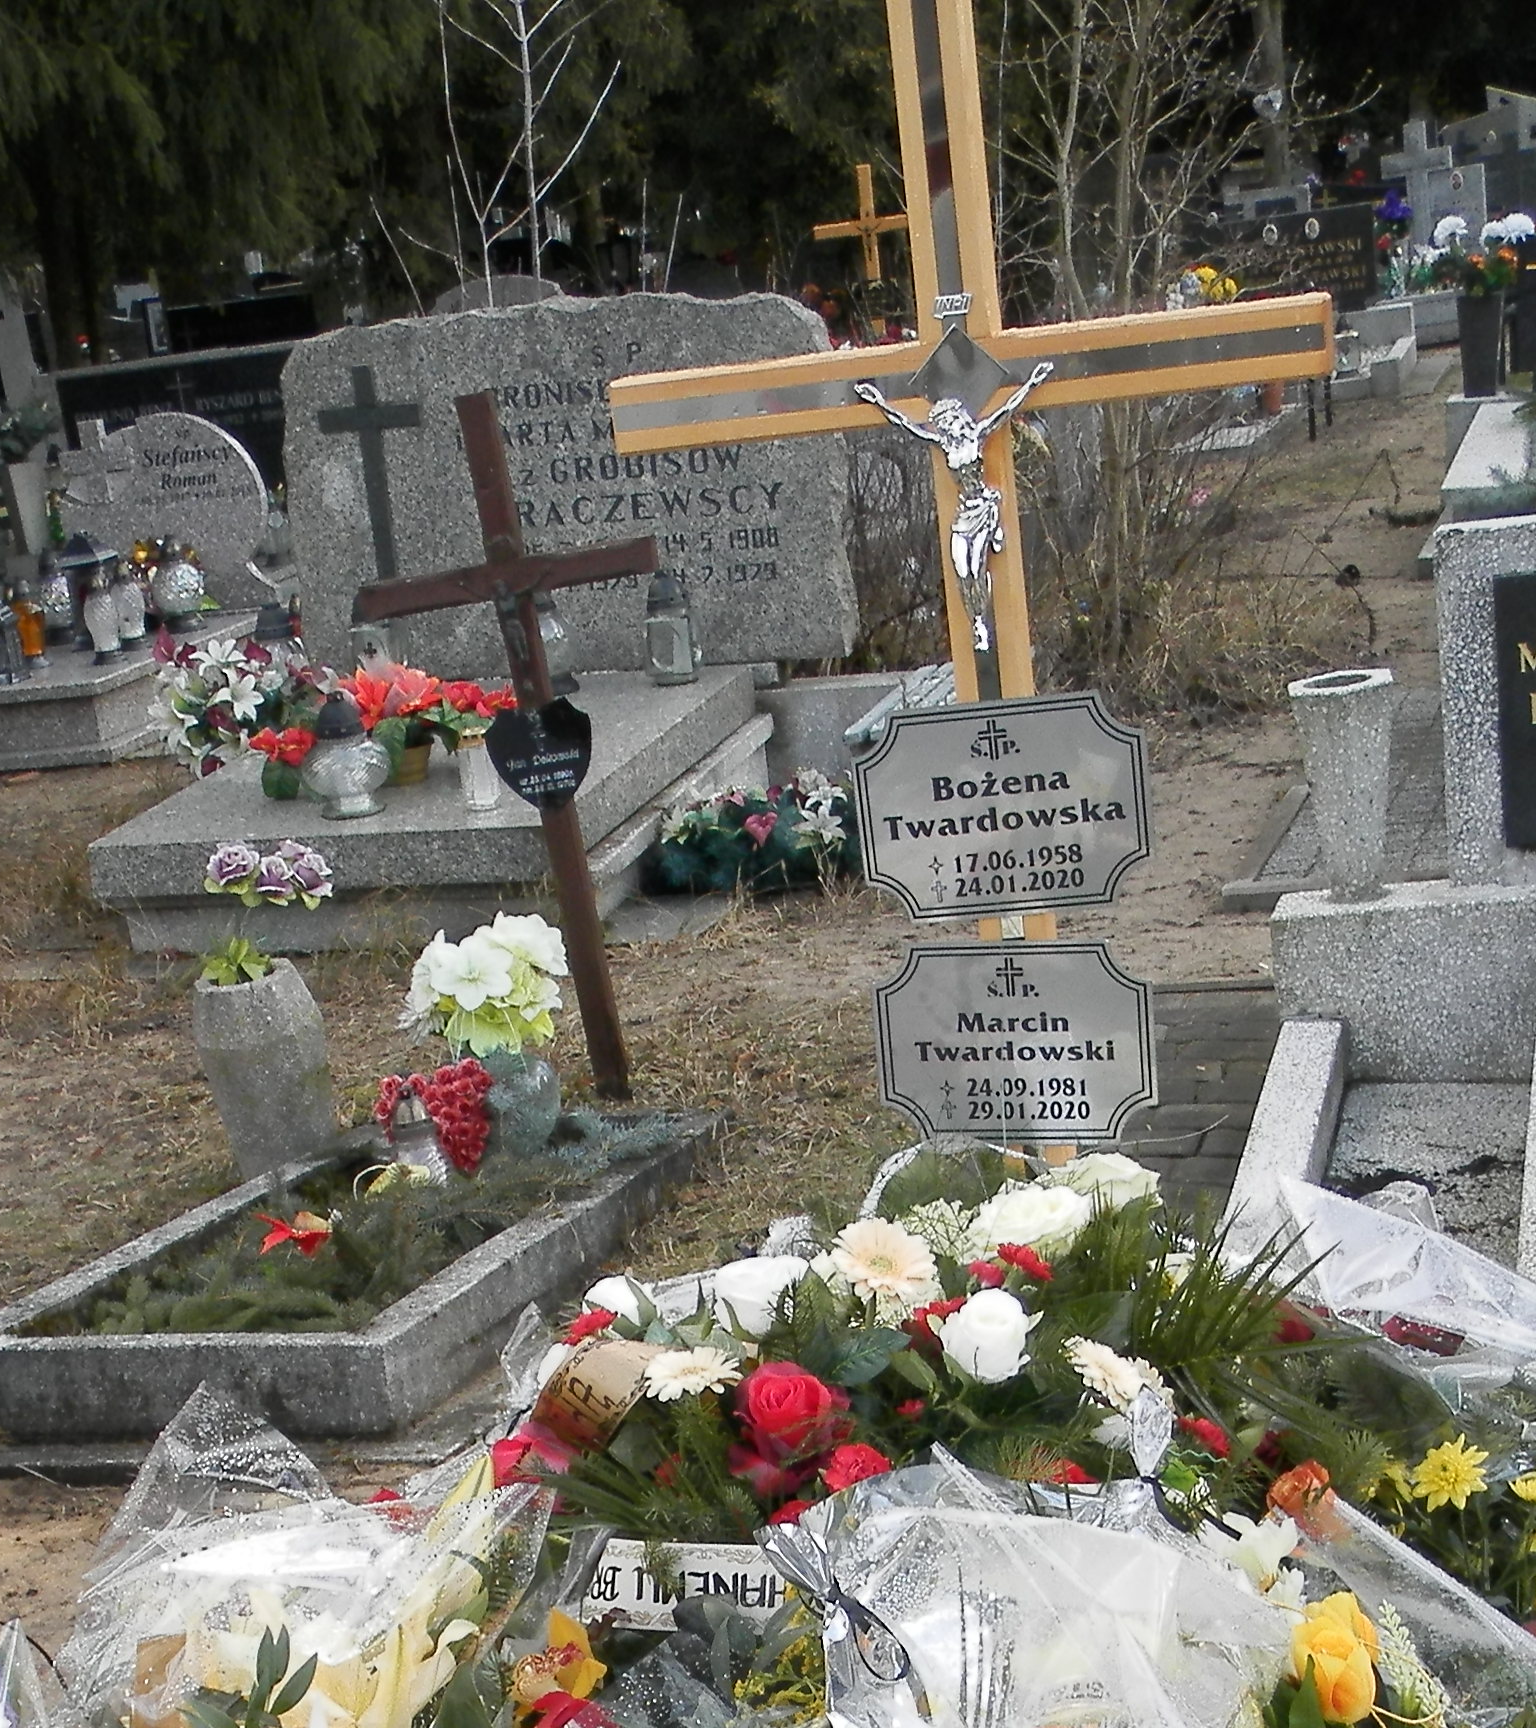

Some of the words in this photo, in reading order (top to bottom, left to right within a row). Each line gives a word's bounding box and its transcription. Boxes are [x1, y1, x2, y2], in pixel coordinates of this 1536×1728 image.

[161, 471, 218, 491] Roman
[729, 527, 780, 550] 1908
[931, 770, 1071, 803] Bożena
[883, 798, 1127, 841] Twardowska
[953, 843, 1084, 875] 17.06.1958
[955, 867, 1085, 899] 24.01.2020
[957, 1011, 1070, 1033] Marcin
[914, 1040, 1116, 1063] Twardowski
[966, 1078, 1087, 1098] 24.09.1981
[968, 1101, 1091, 1121] 29.01.2020
